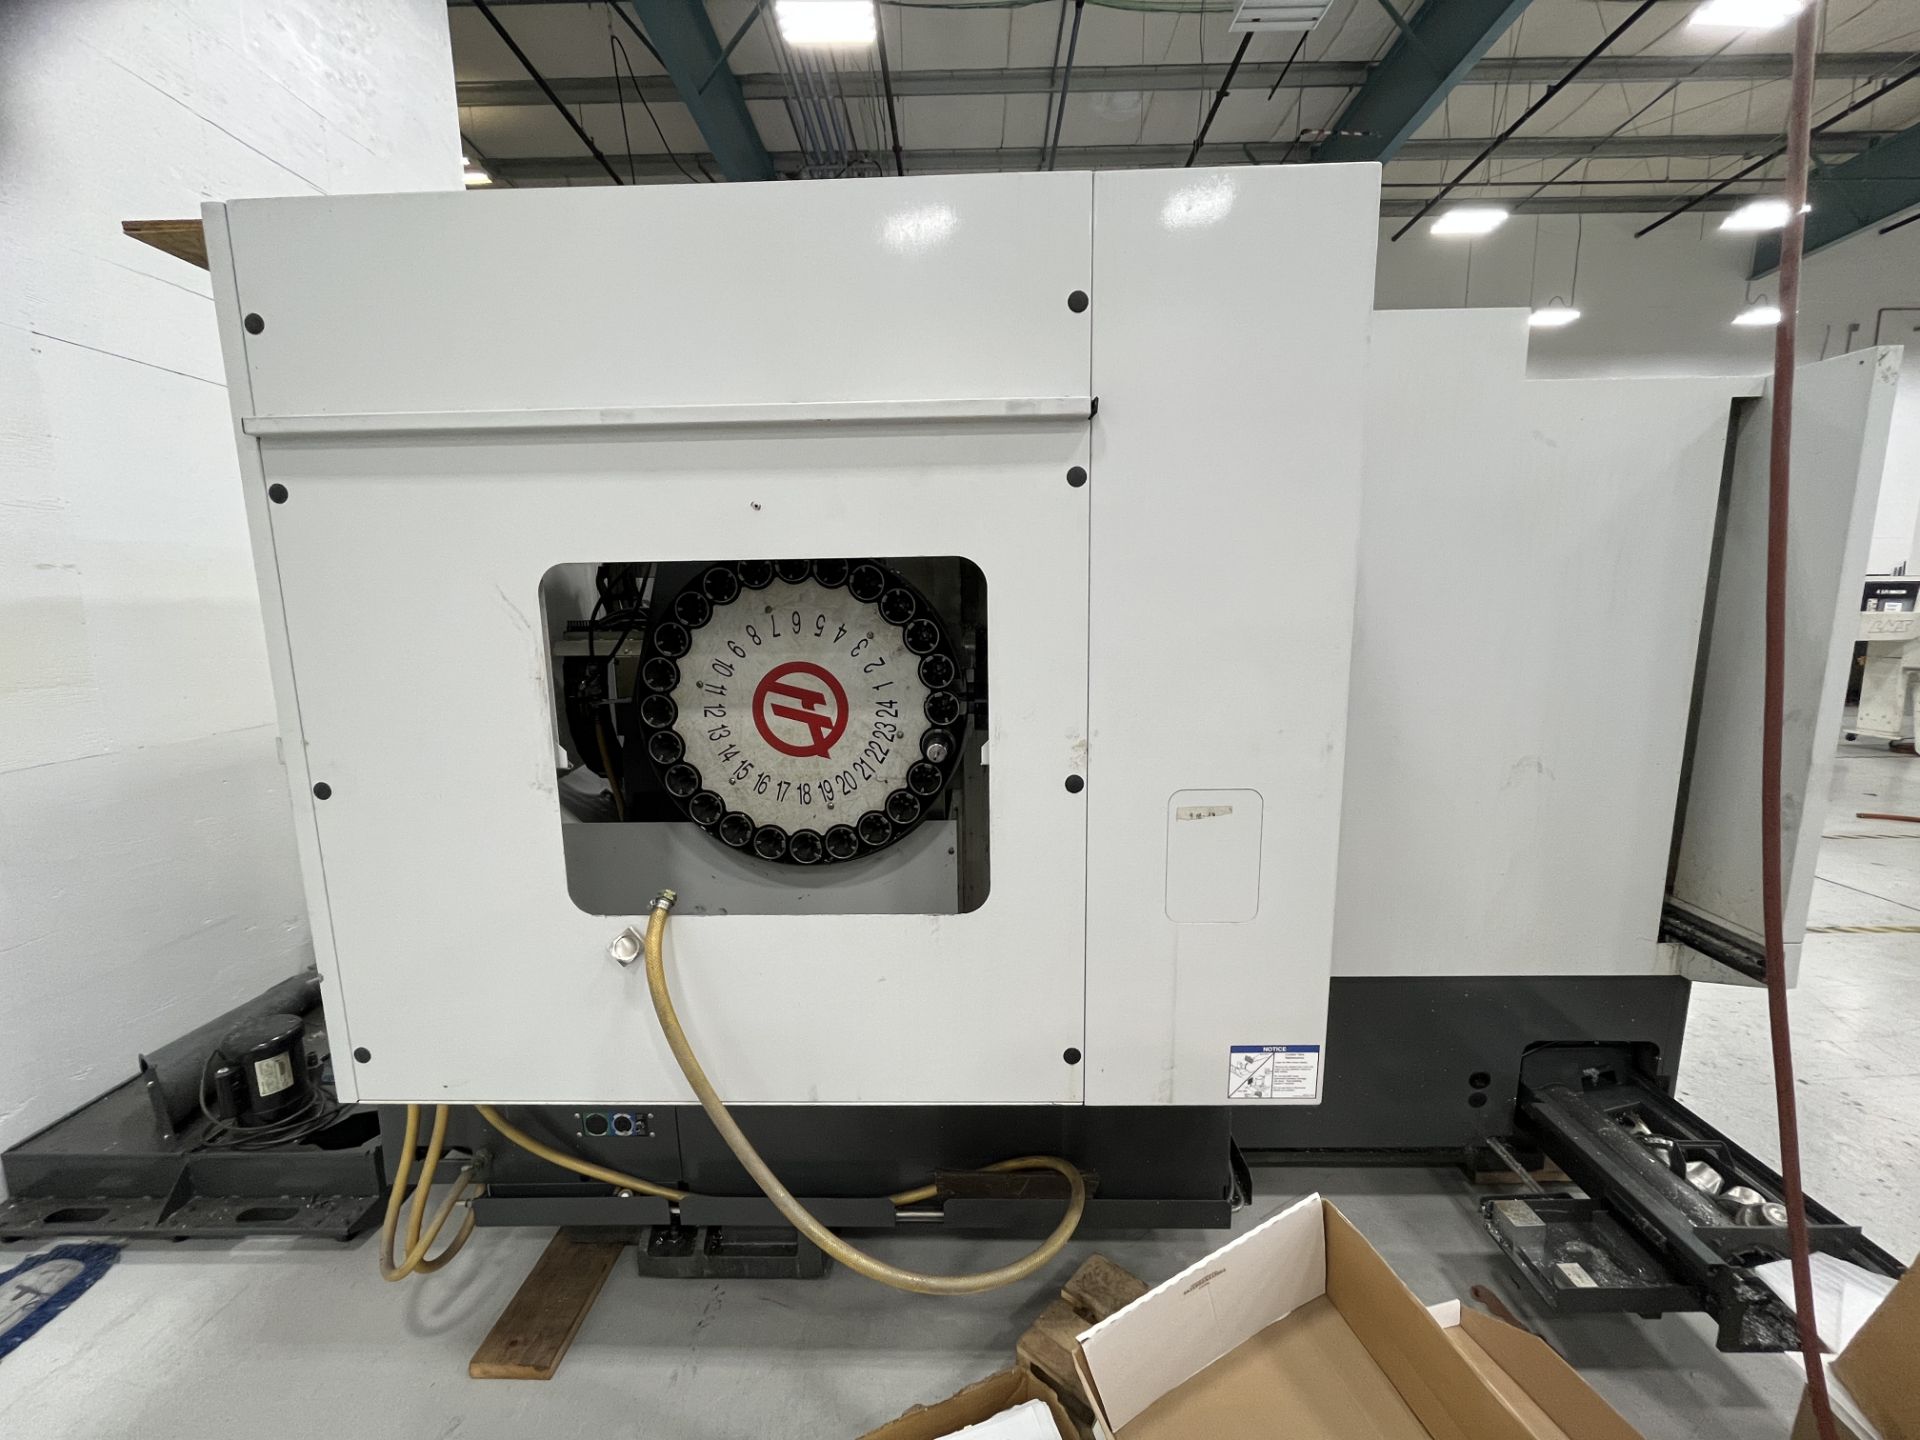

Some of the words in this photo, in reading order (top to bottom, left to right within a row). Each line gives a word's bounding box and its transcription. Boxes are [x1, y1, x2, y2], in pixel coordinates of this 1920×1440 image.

[771, 615, 781, 637] 7
[792, 611, 801, 634] 6
[814, 614, 825, 637] 5
[746, 625, 761, 646] 8
[833, 623, 847, 643] 4
[727, 641, 746, 658] 9
[851, 638, 868, 657] 3
[712, 658, 735, 677] 10
[864, 657, 886, 673] 2
[705, 684, 727, 696] 11
[872, 682, 894, 691] 1
[704, 704, 726, 717] 12
[875, 700, 898, 718] 24
[708, 724, 731, 741] 13
[874, 722, 897, 742] 23
[718, 744, 741, 763] 14
[864, 740, 890, 764] 22
[733, 760, 754, 781] 15
[853, 756, 876, 781] 21
[753, 772, 771, 795] 16
[777, 780, 791, 802] 17
[818, 780, 835, 804] 19
[835, 770, 857, 796] 20
[795, 783, 812, 805] 18
